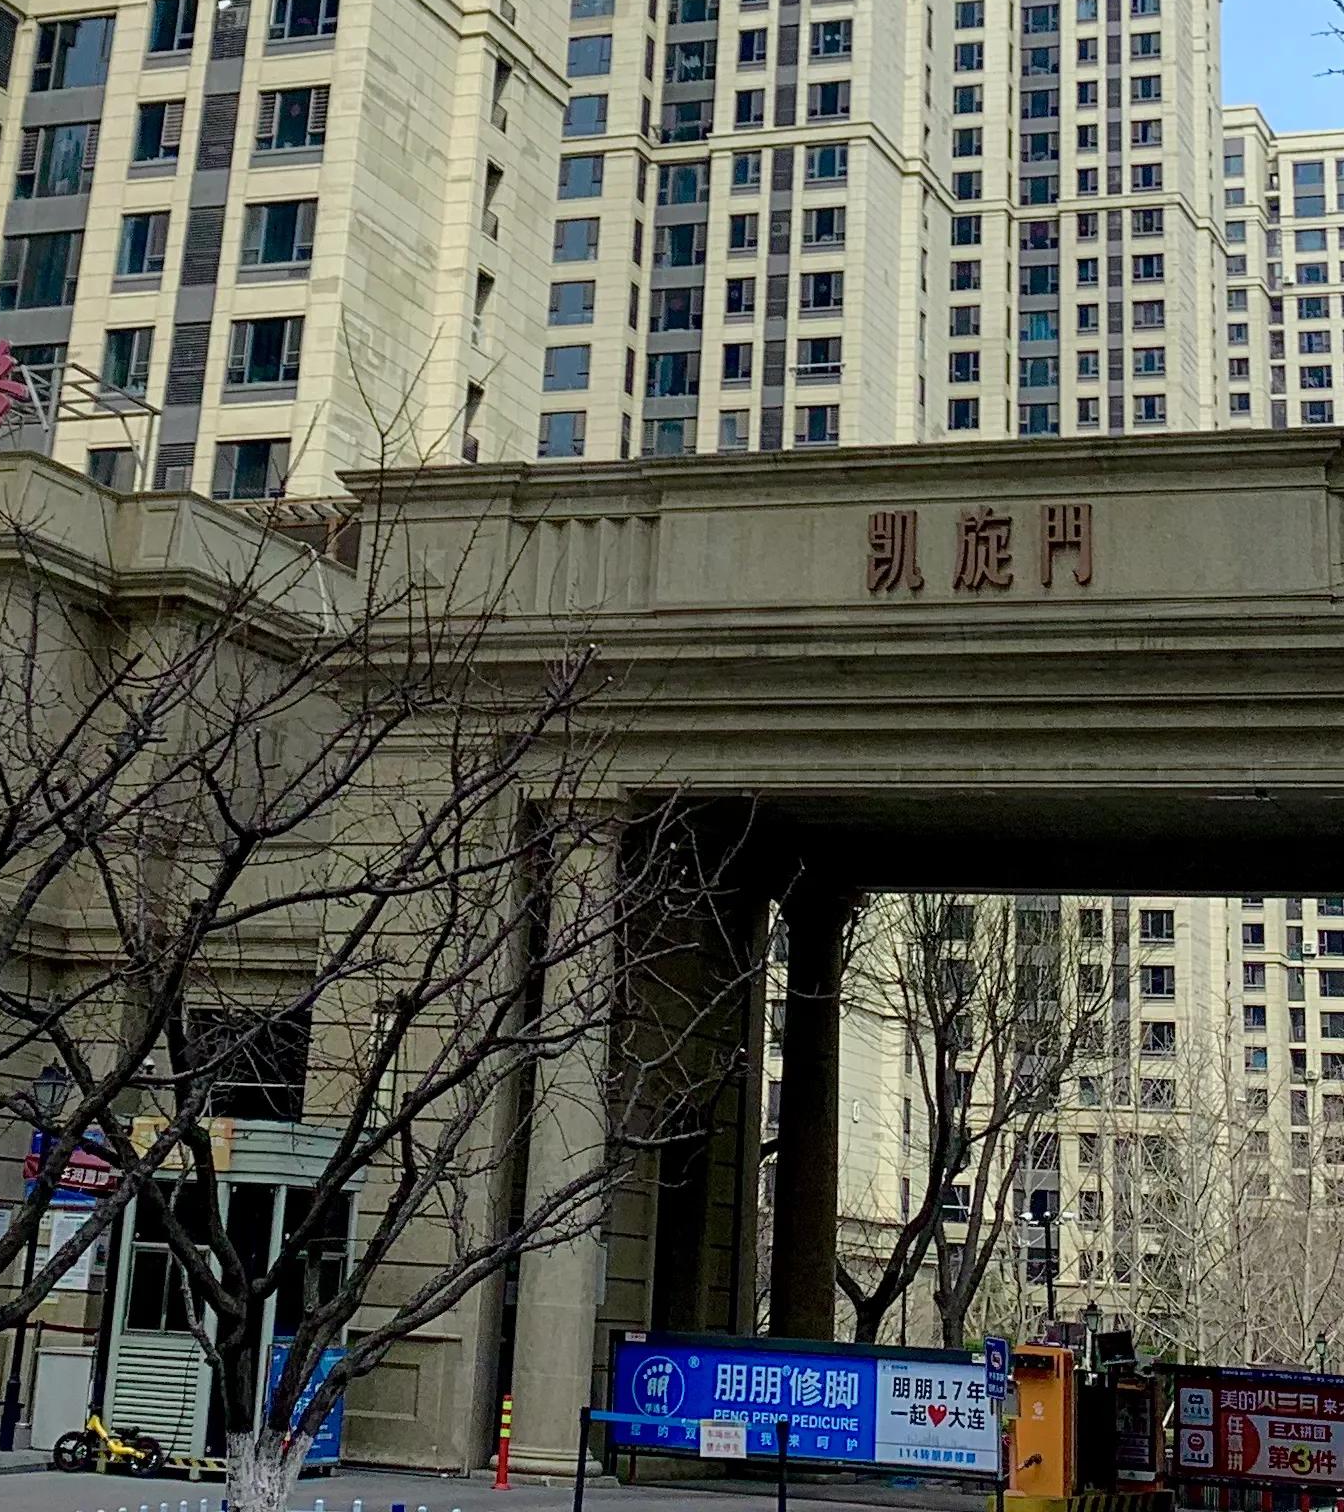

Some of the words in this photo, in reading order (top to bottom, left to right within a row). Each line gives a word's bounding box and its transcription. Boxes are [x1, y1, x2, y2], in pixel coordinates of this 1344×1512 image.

[866, 502, 1093, 592] 凯旋門
[892, 1376, 985, 1404] 朋朋17年
[714, 1409, 749, 1424] PENG
[752, 1410, 788, 1425] PENG
[792, 1414, 858, 1431] PEDICURE
[1268, 1445, 1337, 1476] 第3件
